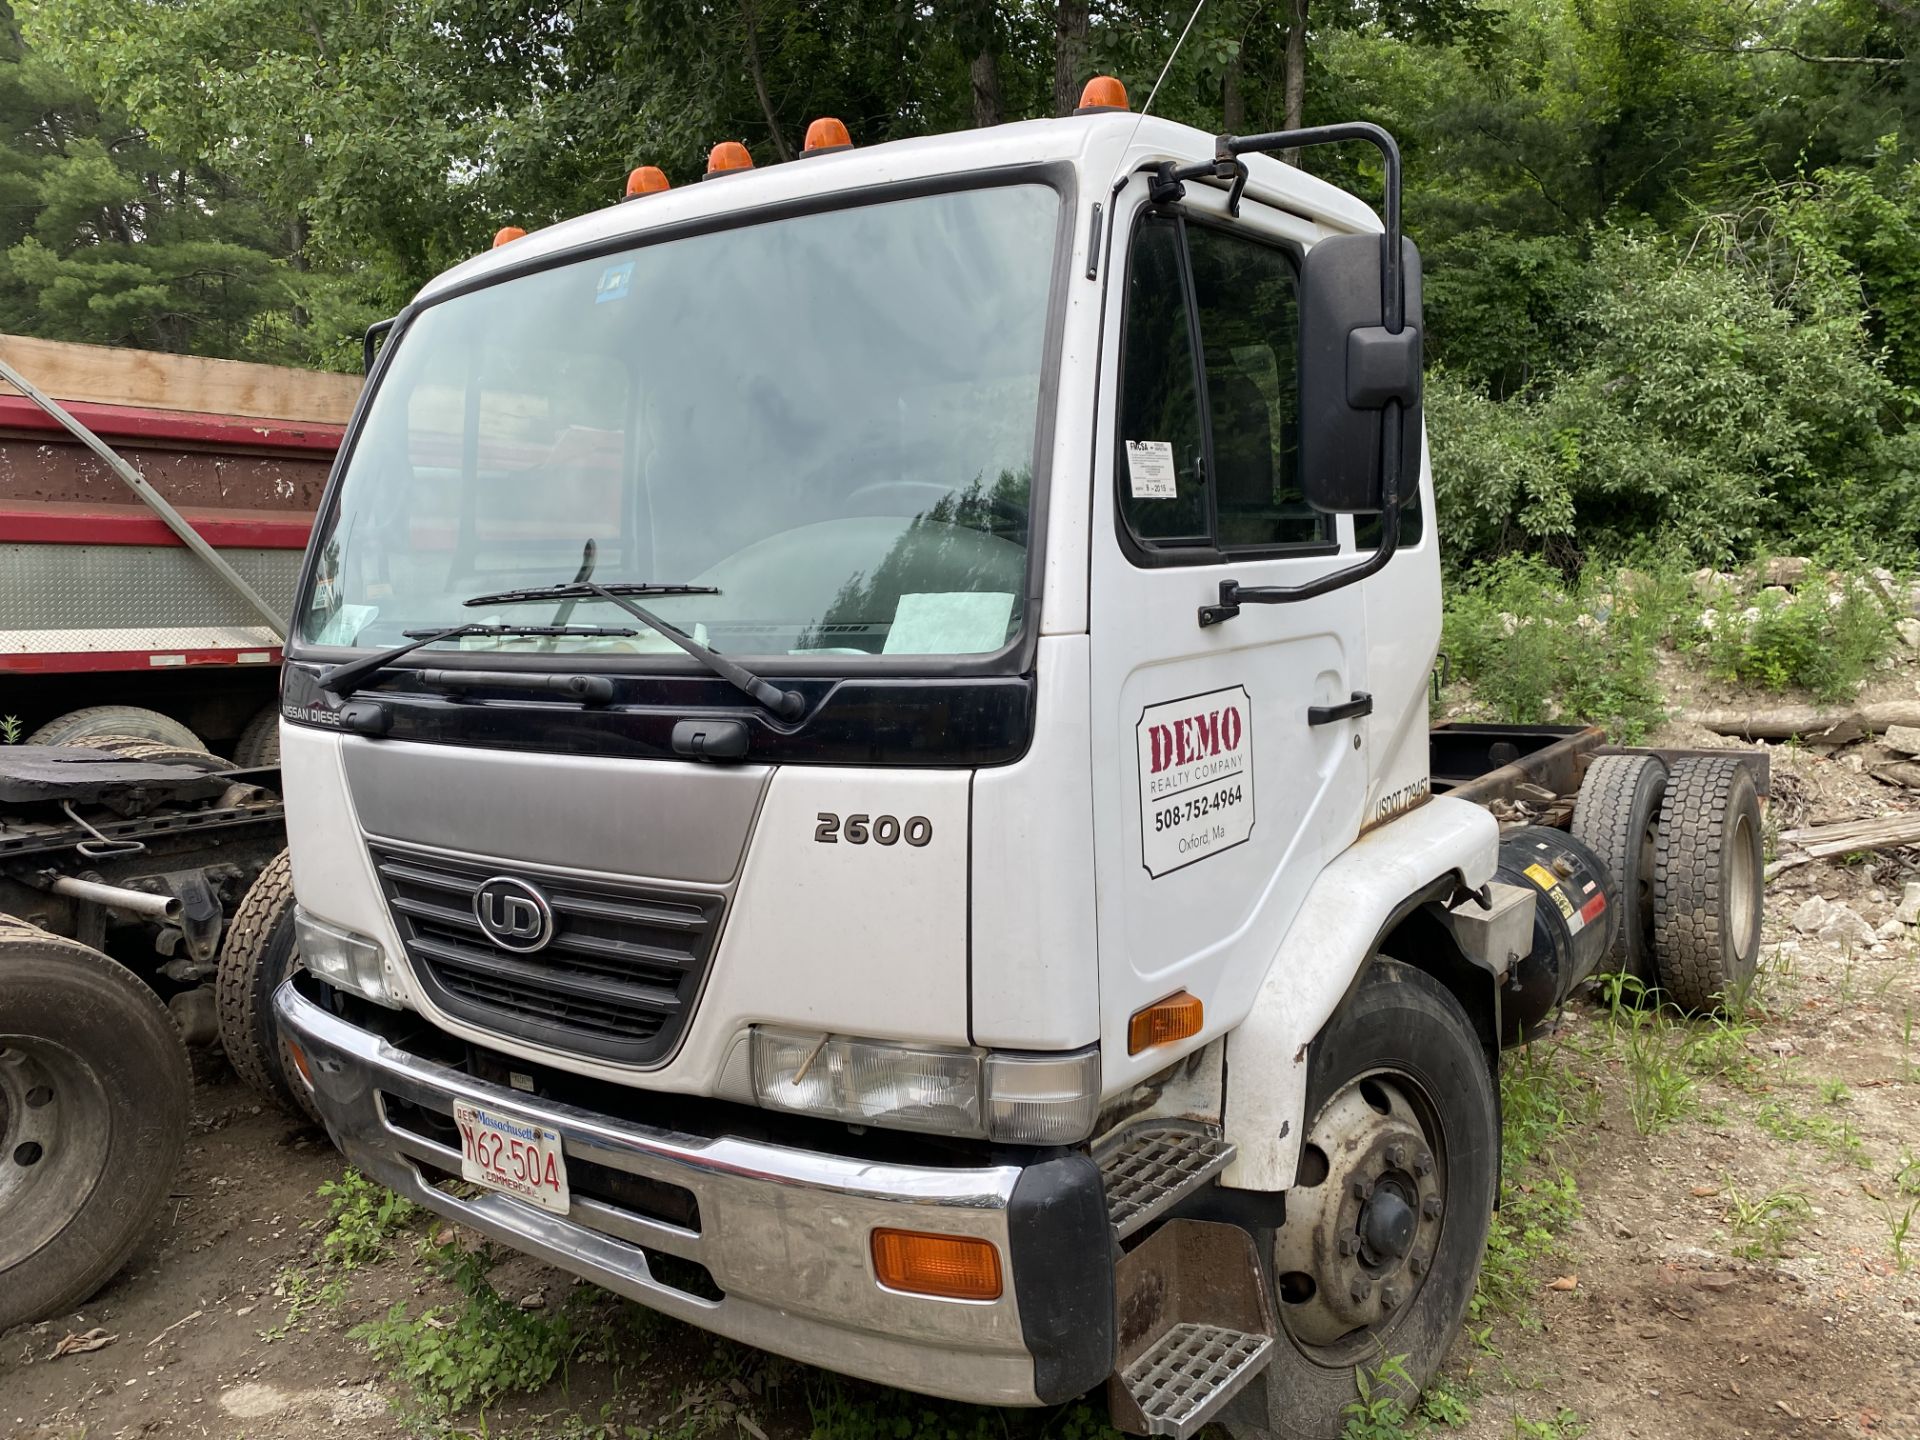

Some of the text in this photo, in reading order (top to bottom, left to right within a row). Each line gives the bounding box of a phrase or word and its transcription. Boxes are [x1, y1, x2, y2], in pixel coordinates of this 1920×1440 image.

[282, 705, 340, 726] NISSAN DIESE
[1148, 706, 1242, 774] DEMO
[1150, 754, 1243, 794] REALTY COMPANY
[1155, 785, 1243, 832] 508-752-4964
[1375, 789, 1402, 821] USDOT
[814, 812, 933, 848] 2600
[1178, 824, 1225, 853] Oxford, Ma
[482, 892, 541, 939] UD
[486, 1171, 540, 1198] COMMERCIAL
